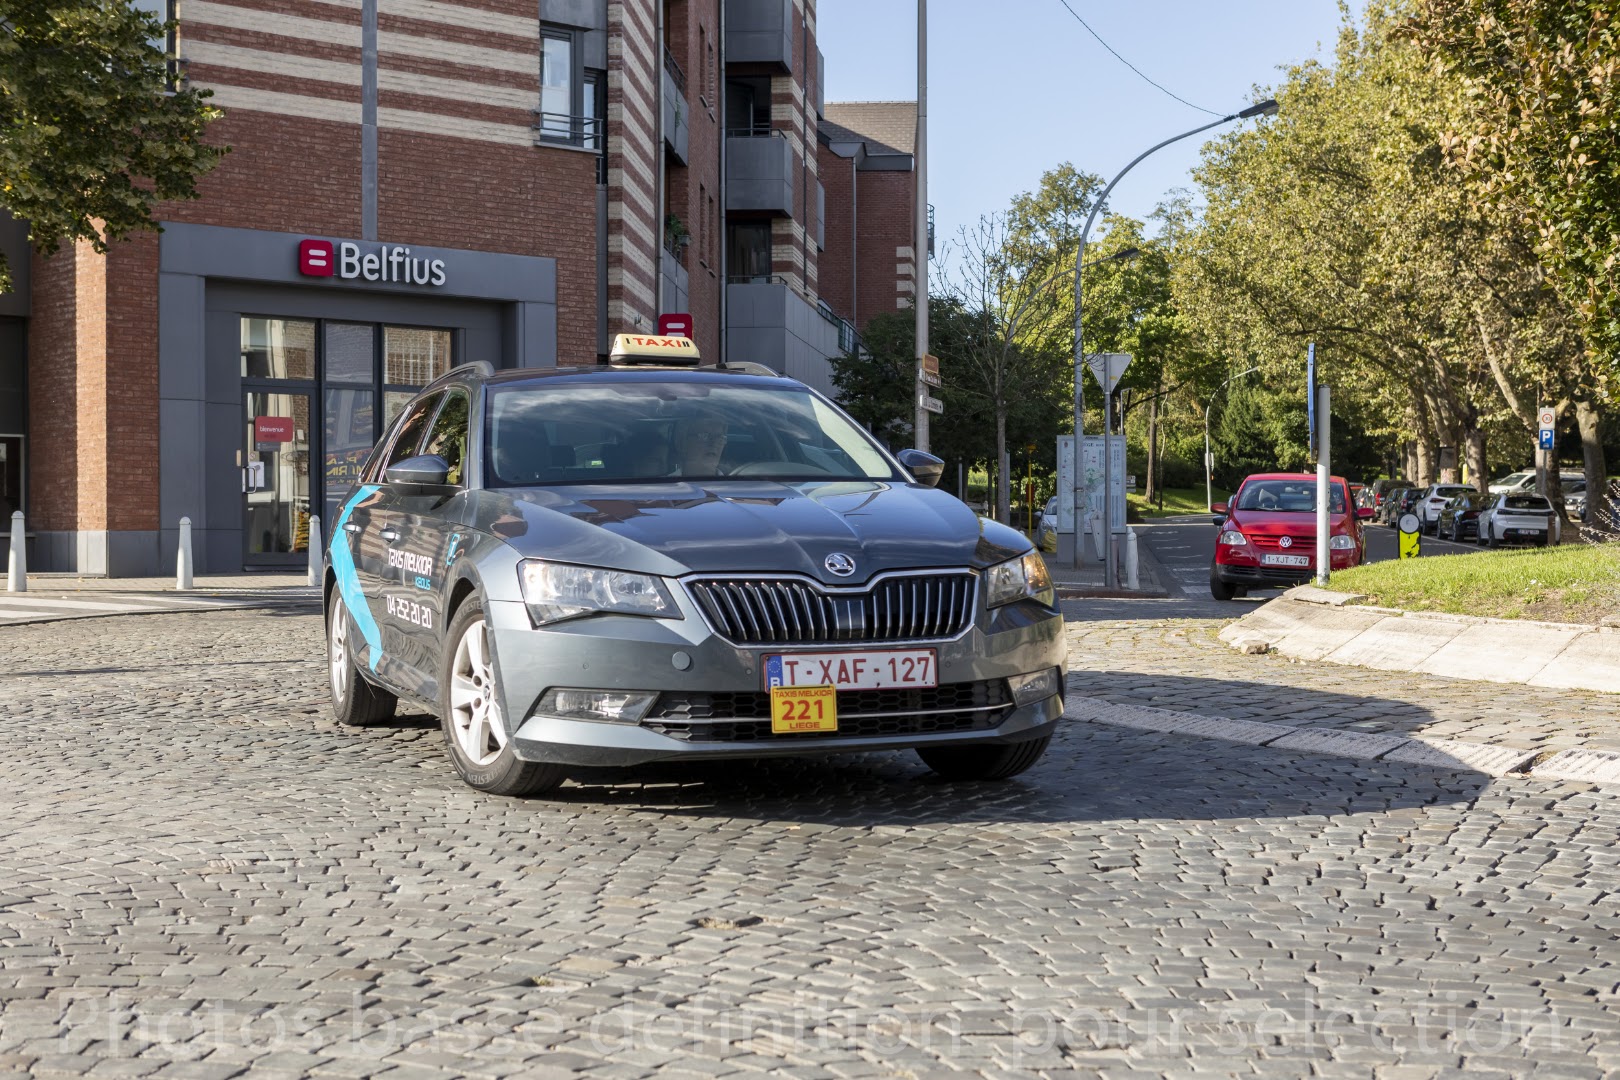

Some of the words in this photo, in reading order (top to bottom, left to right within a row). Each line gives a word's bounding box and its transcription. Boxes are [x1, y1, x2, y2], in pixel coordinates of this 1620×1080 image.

[340, 242, 446, 286] Belfius
[633, 338, 681, 347] TAXI
[260, 425, 284, 433] bienvenue
[1542, 431, 1551, 442] P
[387, 595, 396, 615] 04
[397, 598, 410, 621] 252
[411, 602, 420, 625] 20
[421, 606, 432, 629] 20
[785, 657, 930, 685] T-XAF-127
[798, 689, 833, 697] MELKIOR
[782, 700, 824, 721] 221
[789, 722, 820, 730] LIEGE
